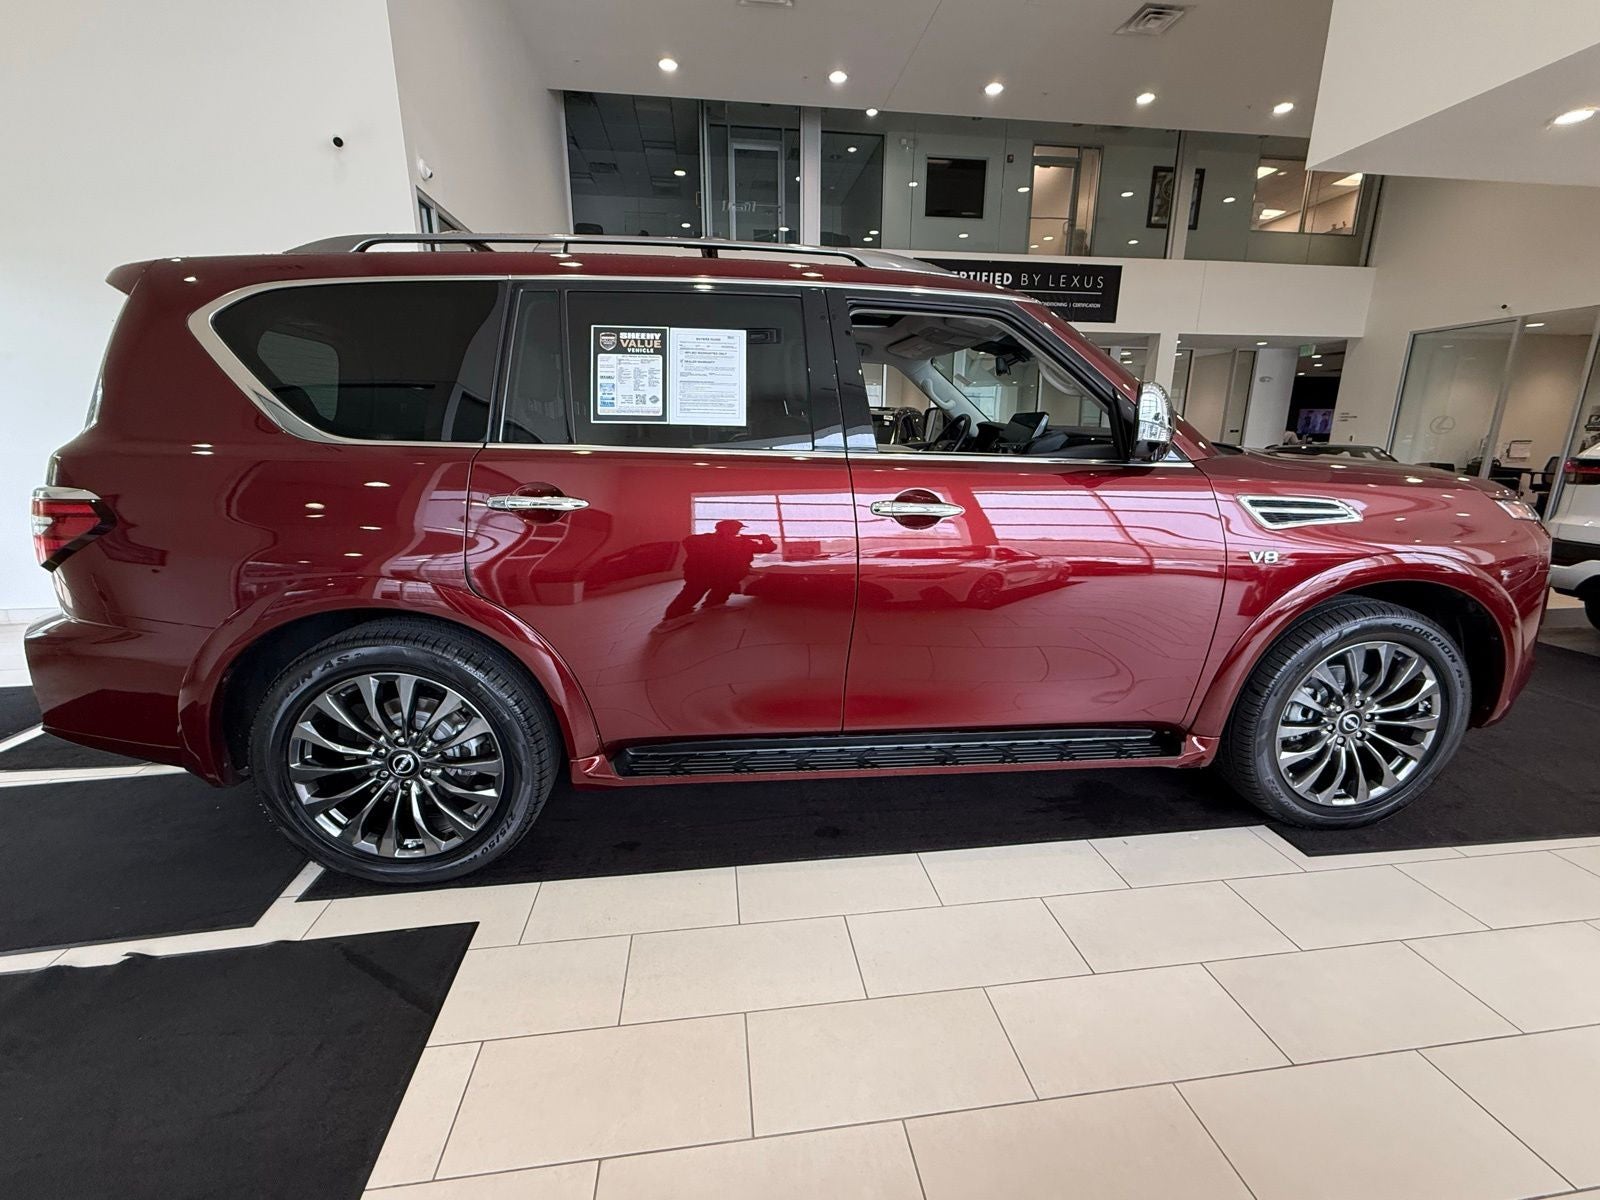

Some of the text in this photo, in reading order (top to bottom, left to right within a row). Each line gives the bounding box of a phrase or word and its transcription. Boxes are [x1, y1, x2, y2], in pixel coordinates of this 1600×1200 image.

[952, 270, 1104, 289] RTIFIED BY LEXUS
[619, 332, 662, 340] SHEEHY
[620, 339, 662, 348] VALUE
[1248, 550, 1279, 565] V8
[1391, 622, 1457, 663] SCORPION
